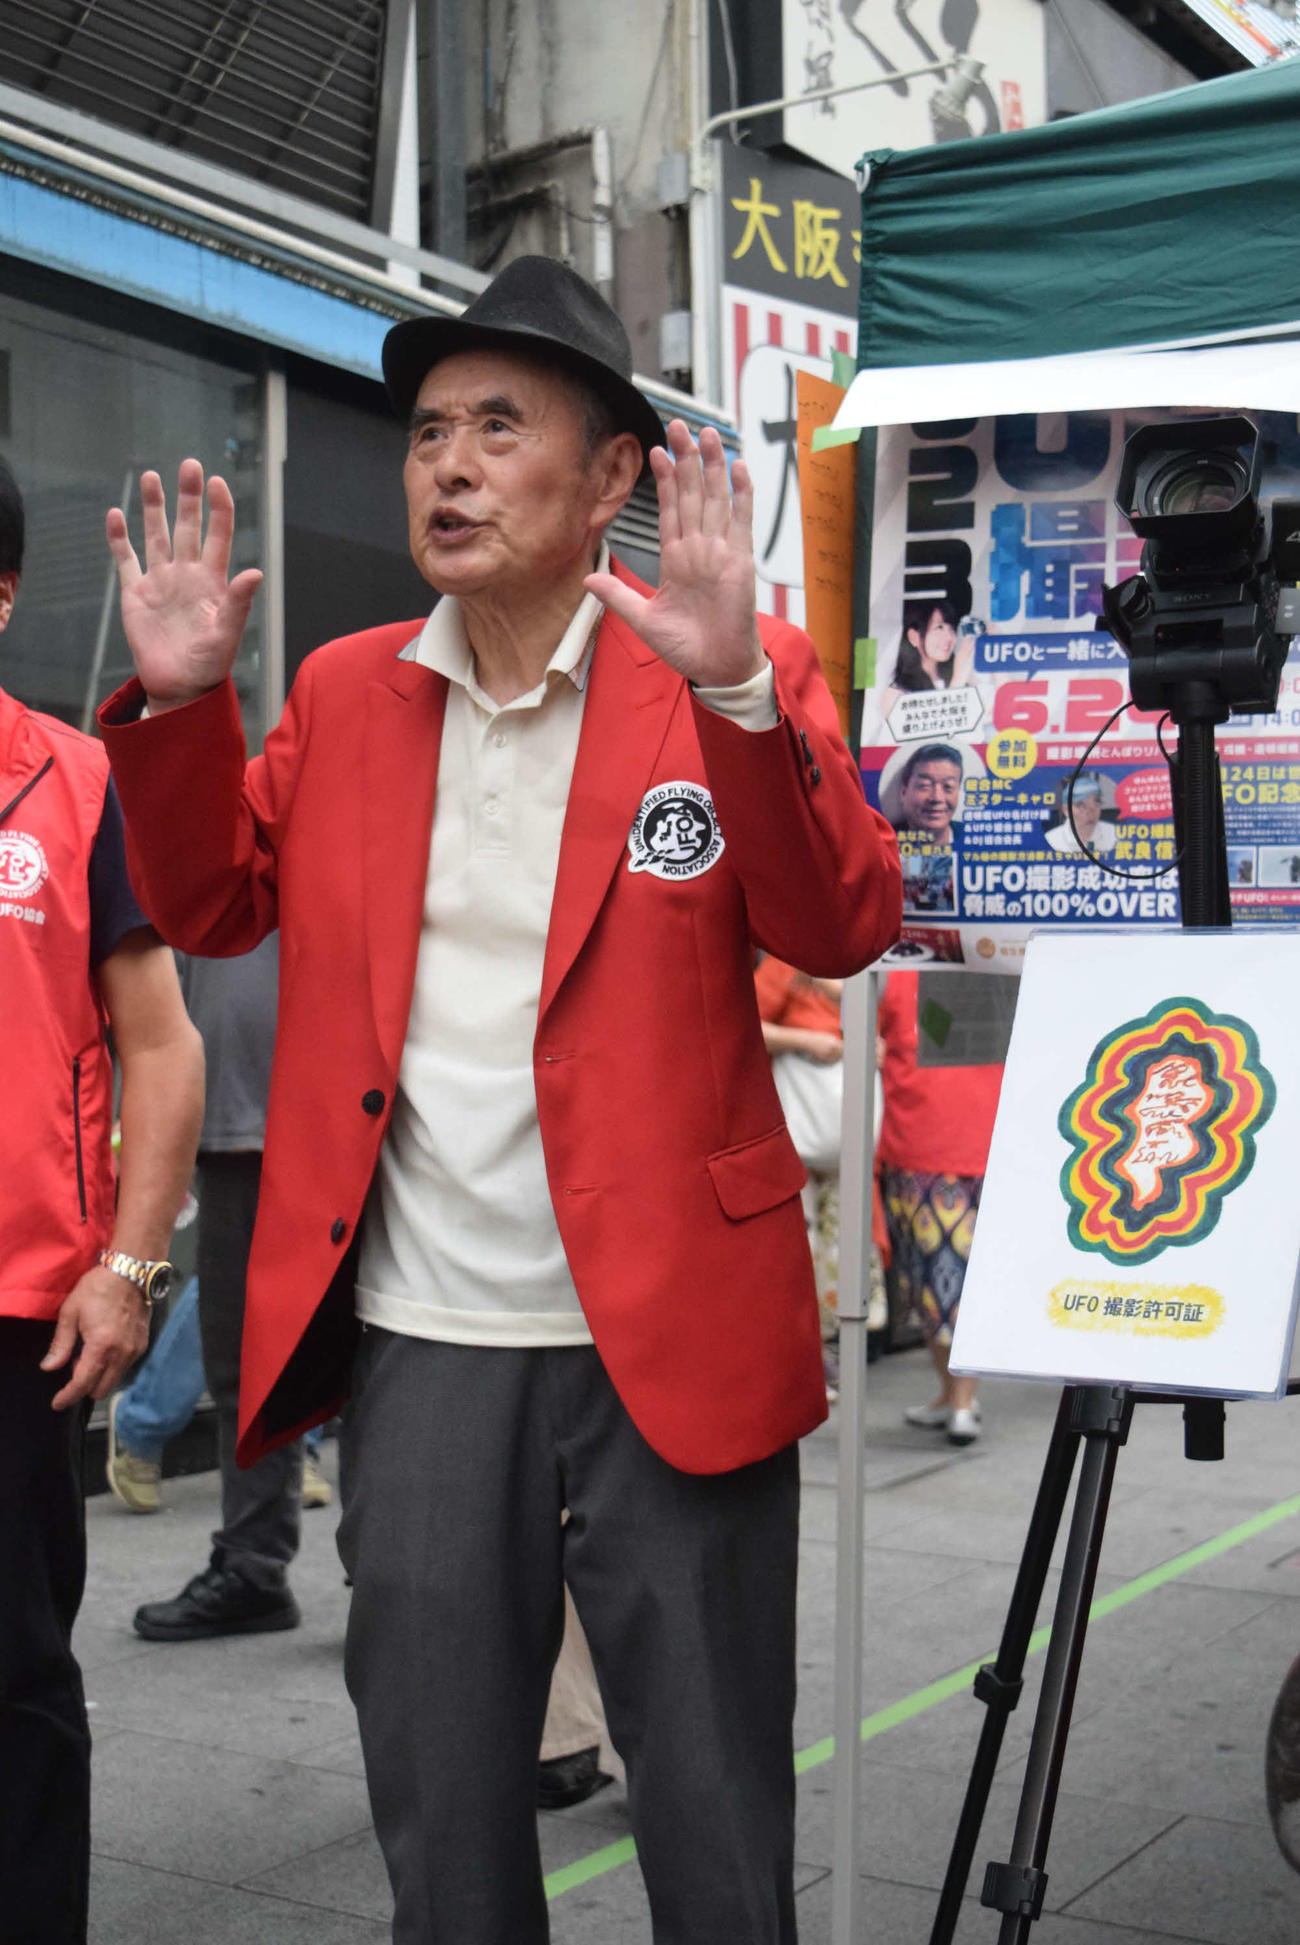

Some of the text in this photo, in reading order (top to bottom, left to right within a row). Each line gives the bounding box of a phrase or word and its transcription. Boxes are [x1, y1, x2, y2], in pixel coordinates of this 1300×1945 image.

[731, 178, 861, 288] 大阪
[997, 740, 1027, 753] 参加
[997, 755, 1026, 769] 無料
[668, 787, 704, 802] FLYING
[633, 791, 666, 853] UNIDENTIFIED
[662, 838, 720, 875] ASSOCIATION
[962, 864, 1179, 893] UFO撮影成功率は
[963, 892, 1177, 917] 脅威の100%OVER
[1063, 1293, 1206, 1323] UFO 撮影許可証
